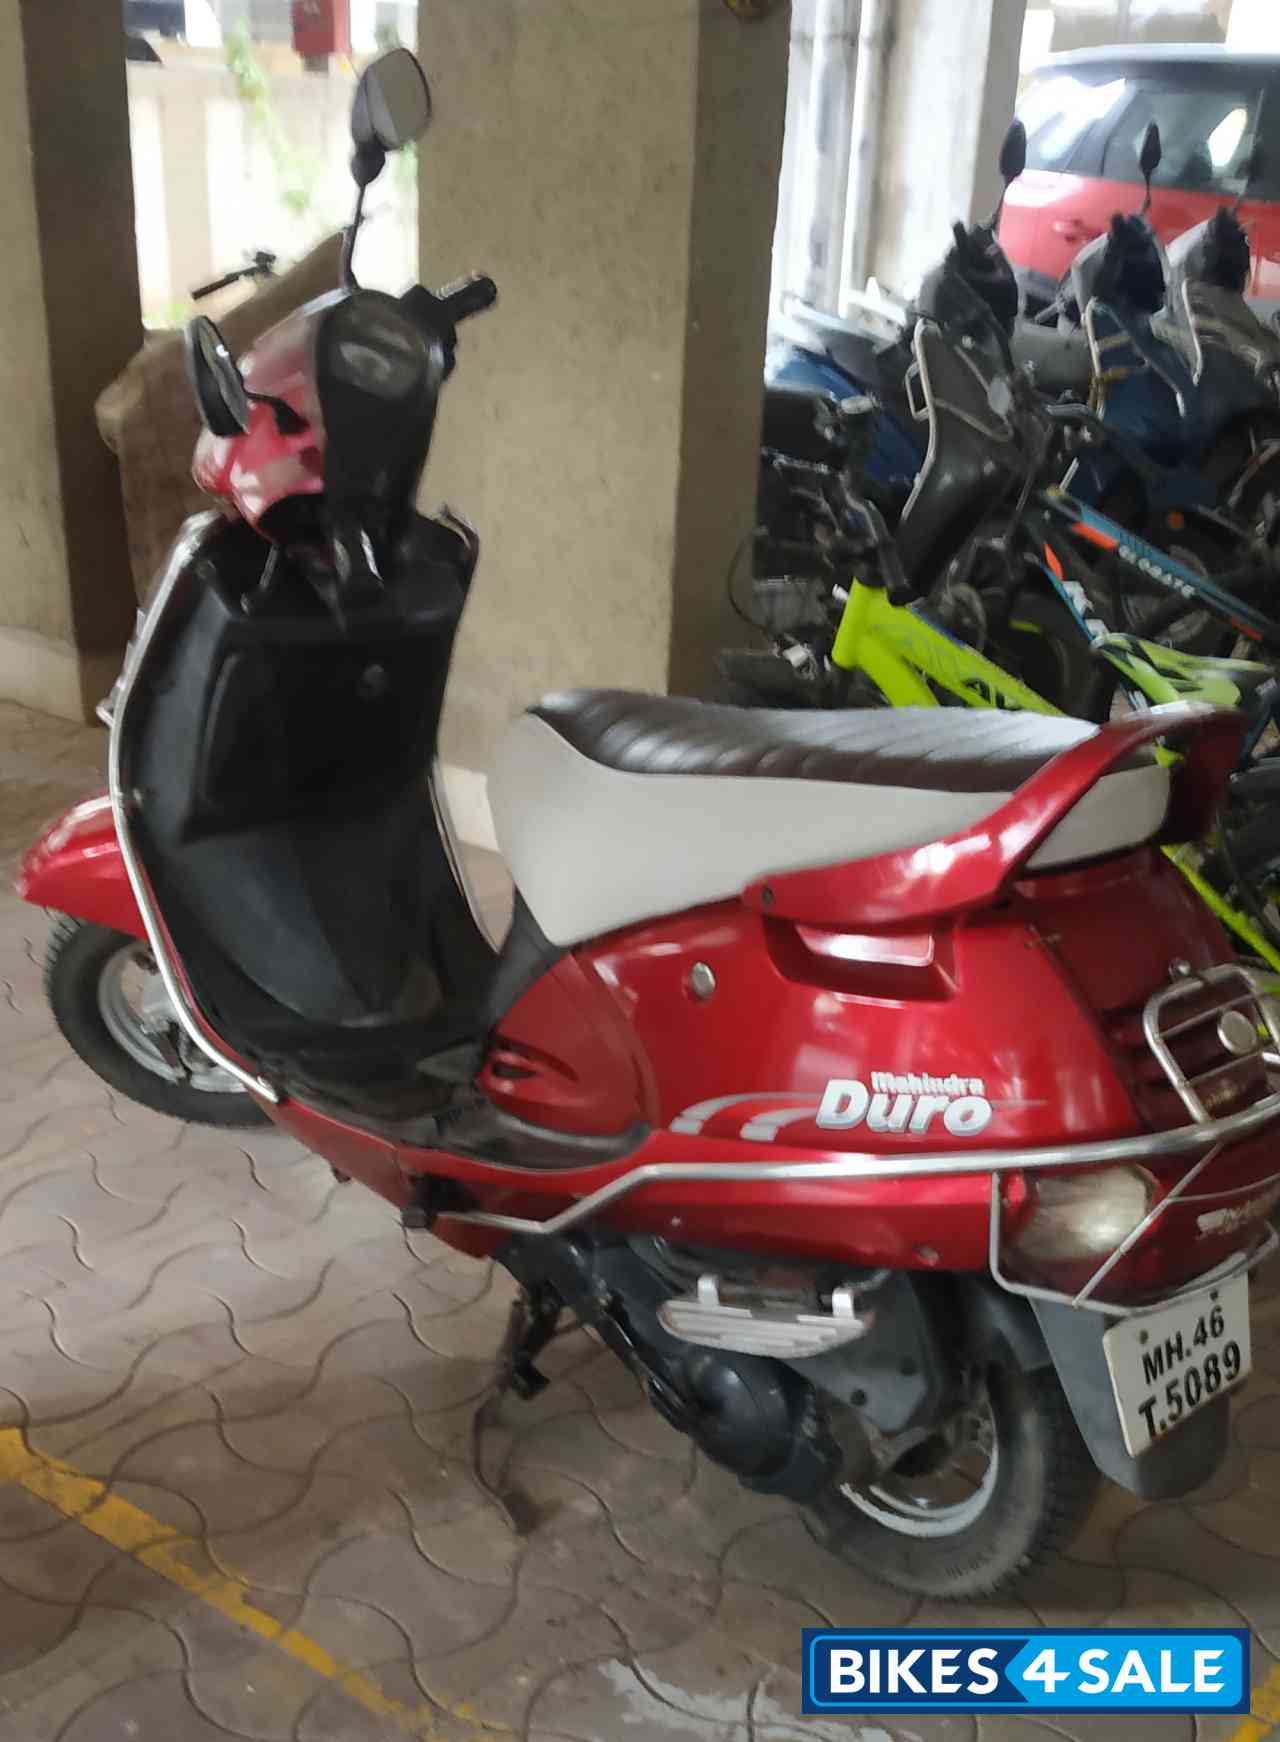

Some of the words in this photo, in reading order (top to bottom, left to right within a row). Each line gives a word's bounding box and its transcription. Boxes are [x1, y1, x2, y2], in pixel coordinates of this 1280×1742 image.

[815, 1079, 993, 1137] Duro
[870, 1071, 985, 1097] Mahindra
[1141, 1303, 1225, 1386] MH.46
[1137, 1340, 1242, 1438] T.5089
